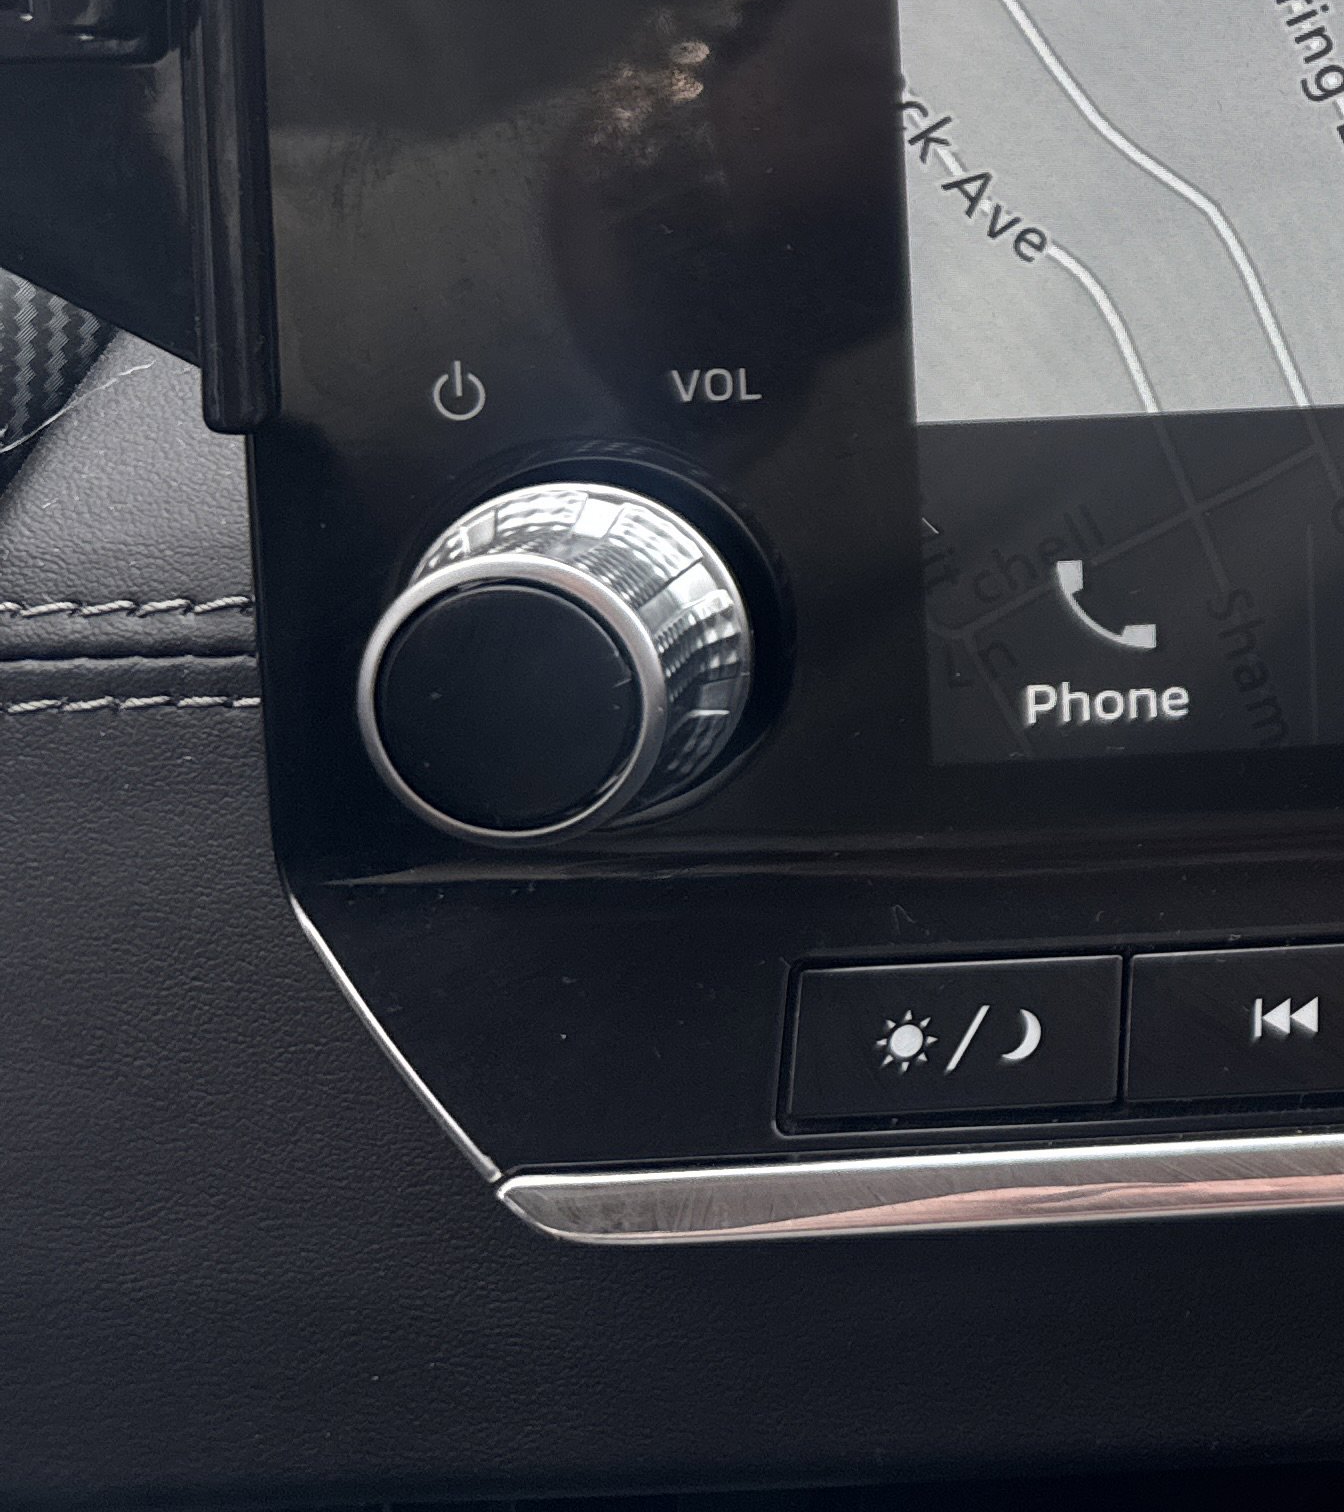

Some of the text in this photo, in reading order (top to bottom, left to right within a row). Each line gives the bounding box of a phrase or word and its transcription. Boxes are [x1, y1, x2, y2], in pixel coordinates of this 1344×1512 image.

[940, 171, 1048, 263] Ave
[670, 367, 763, 402] VOL
[1024, 680, 1190, 727] Phone
